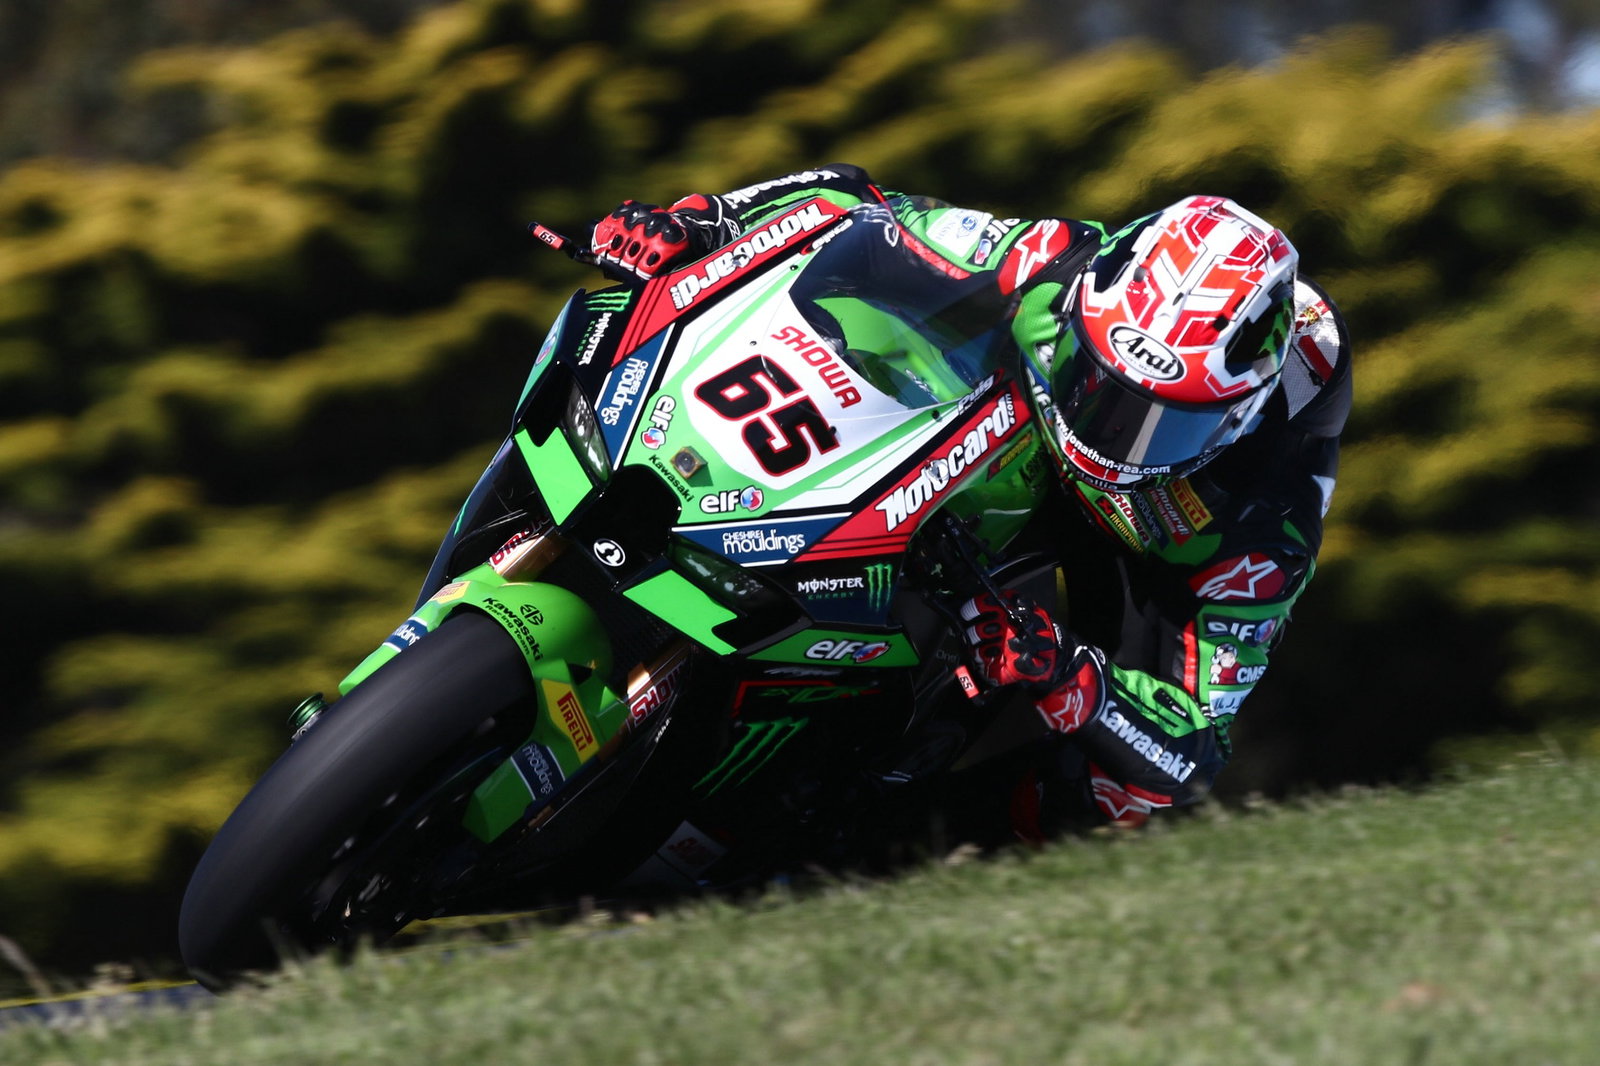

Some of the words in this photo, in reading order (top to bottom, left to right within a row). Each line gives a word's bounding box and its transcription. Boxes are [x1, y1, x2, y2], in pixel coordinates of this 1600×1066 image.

[539, 231, 556, 245] 65
[771, 326, 862, 409] SHOWA
[1112, 336, 1178, 374] Arai
[649, 395, 676, 433] elf
[693, 354, 841, 477] 65
[649, 454, 694, 502] Kawasaki
[700, 491, 740, 514] elf
[722, 531, 762, 542] CHESHIRE
[723, 529, 806, 554] mouldings
[797, 576, 864, 593] MONSTER
[482, 597, 544, 661] Kawasaki
[485, 605, 514, 629] Racing
[514, 628, 530, 655] Team
[805, 639, 855, 660] elf
[958, 675, 974, 690] 65
[556, 691, 594, 752] PIRELLI
[1100, 700, 1196, 784] Kawasaki
